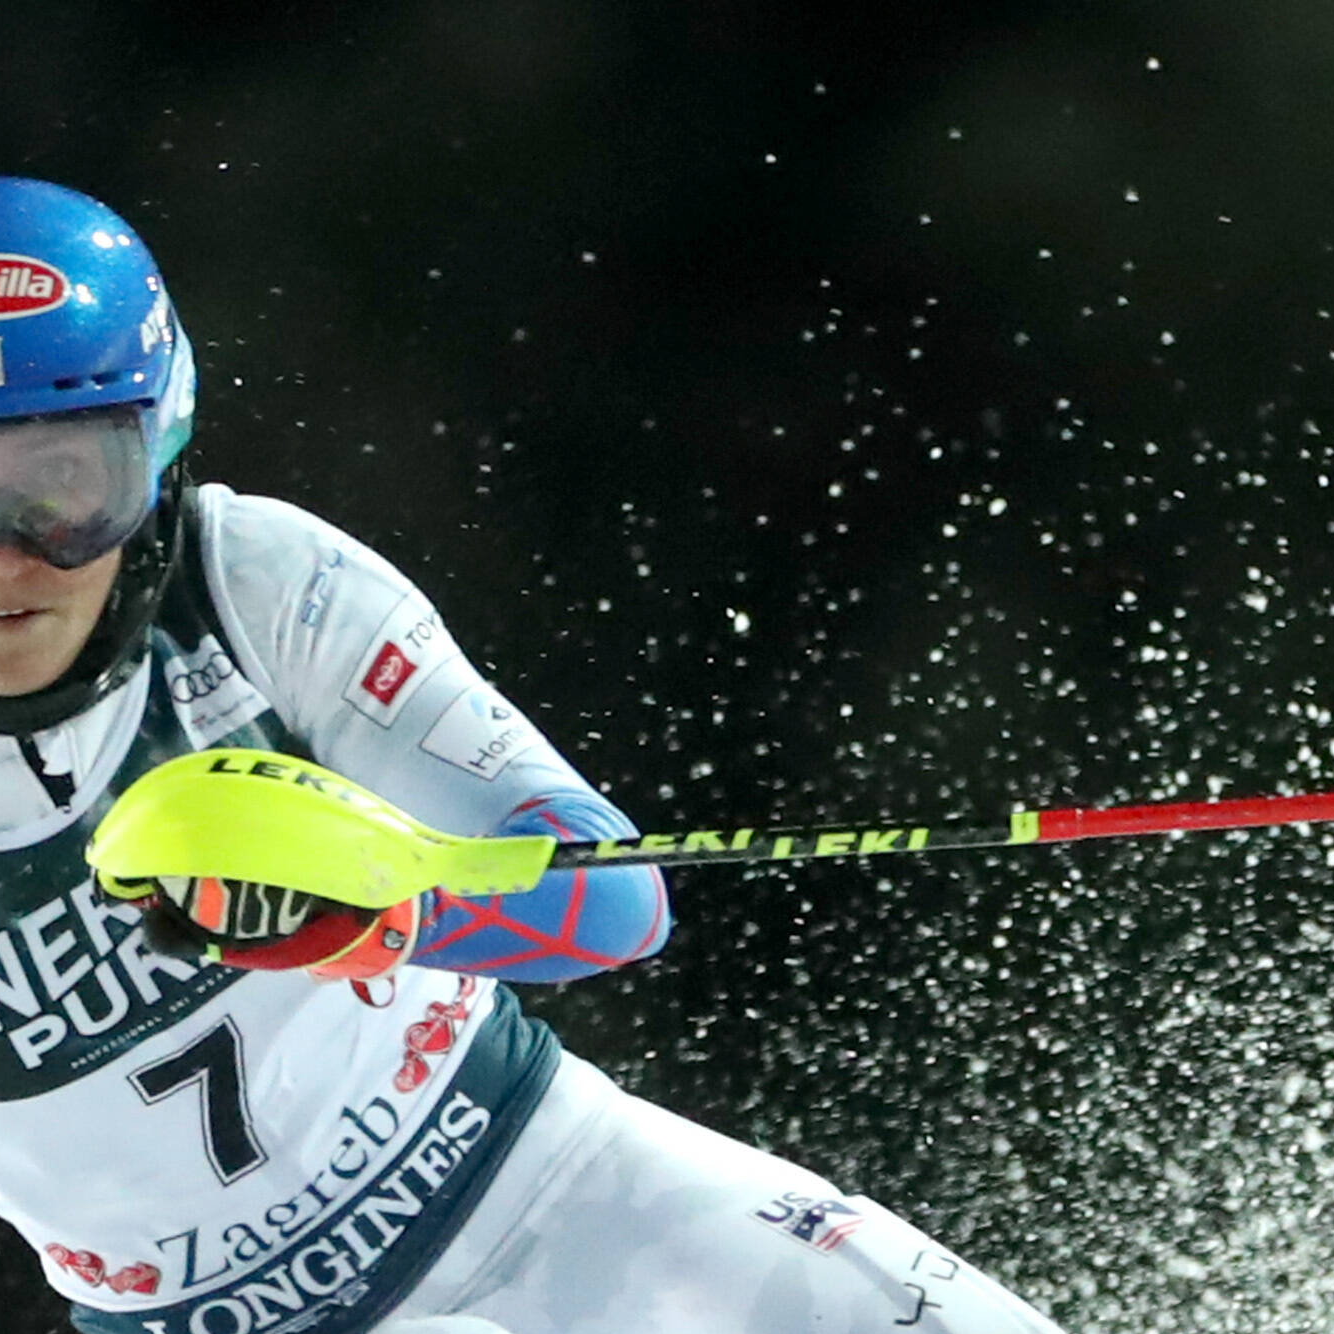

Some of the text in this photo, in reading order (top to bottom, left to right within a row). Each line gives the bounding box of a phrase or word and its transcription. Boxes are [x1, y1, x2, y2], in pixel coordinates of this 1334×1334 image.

[595, 827, 931, 860] LEKI LEKI
[126, 1014, 269, 1186] 7
[156, 1096, 399, 1291] Zagreb
